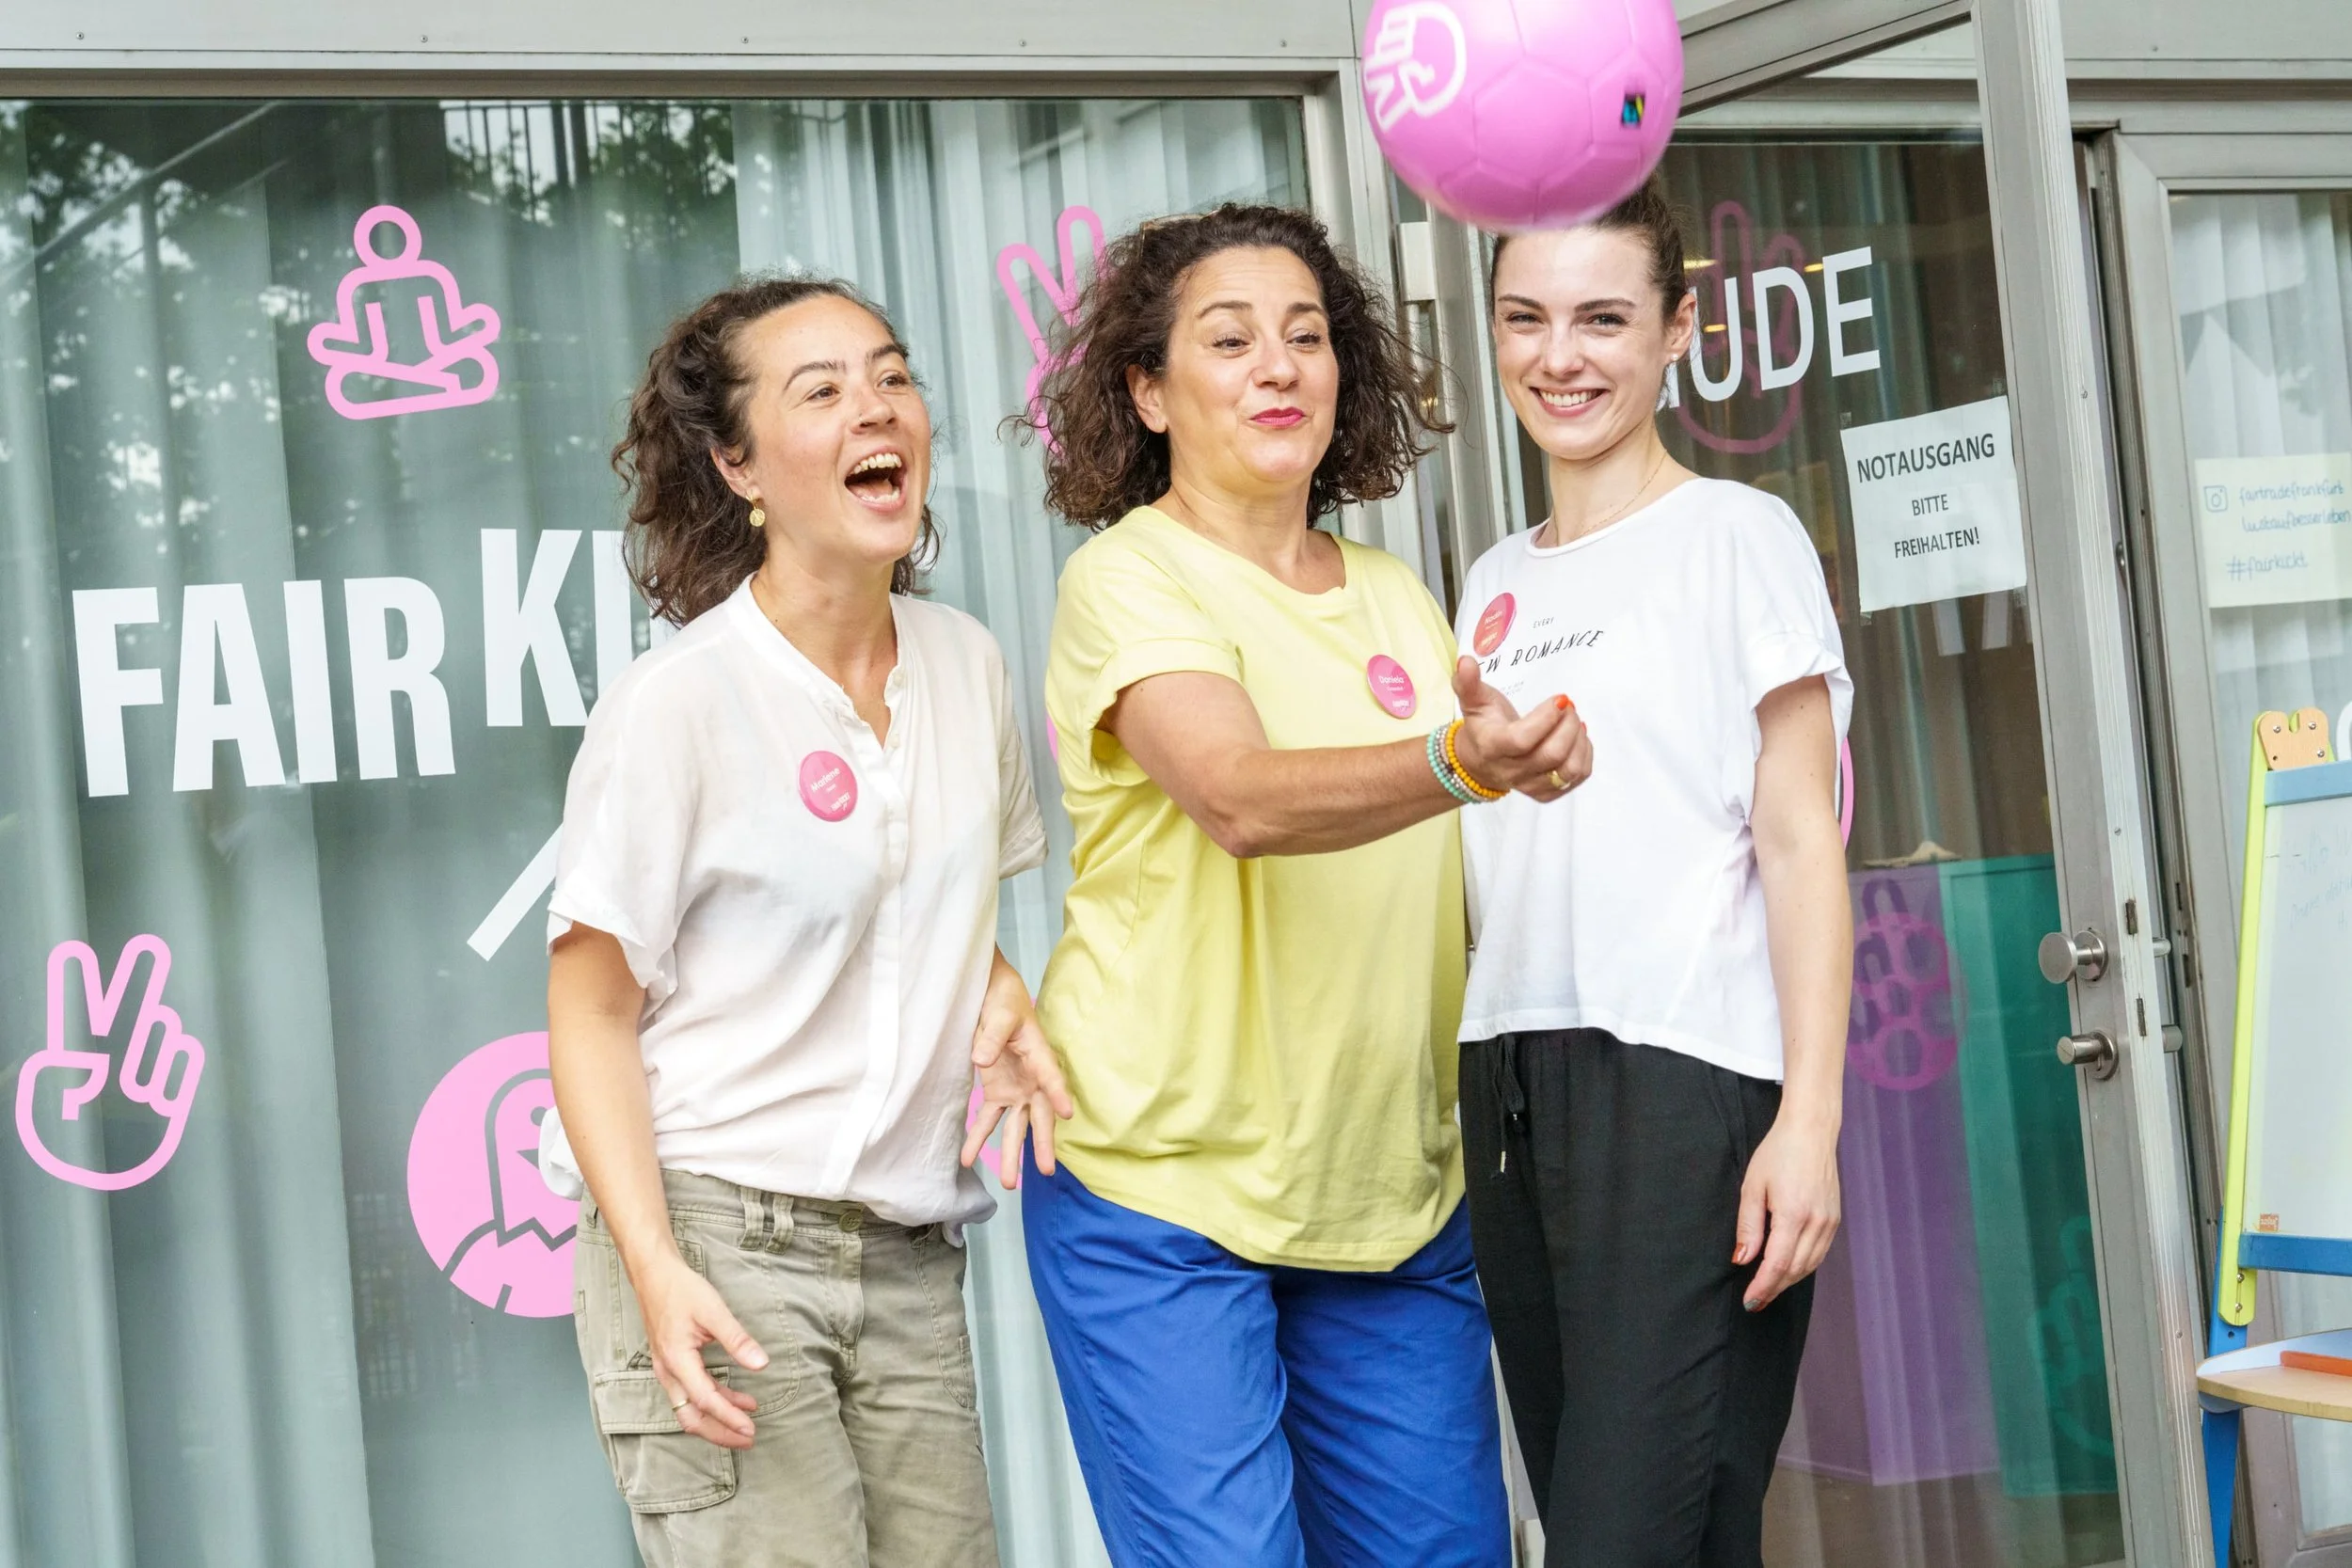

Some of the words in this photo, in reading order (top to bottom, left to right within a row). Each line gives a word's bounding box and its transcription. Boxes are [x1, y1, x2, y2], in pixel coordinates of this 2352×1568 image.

[1857, 433, 1995, 483] NOTAUSGANG
[1911, 494, 1949, 516] BITTE
[1894, 527, 1980, 559] FREIHALTEN!
[72, 576, 456, 798] FAIR
[480, 528, 681, 727] KI
[1510, 629, 1605, 667] ROMANCE
